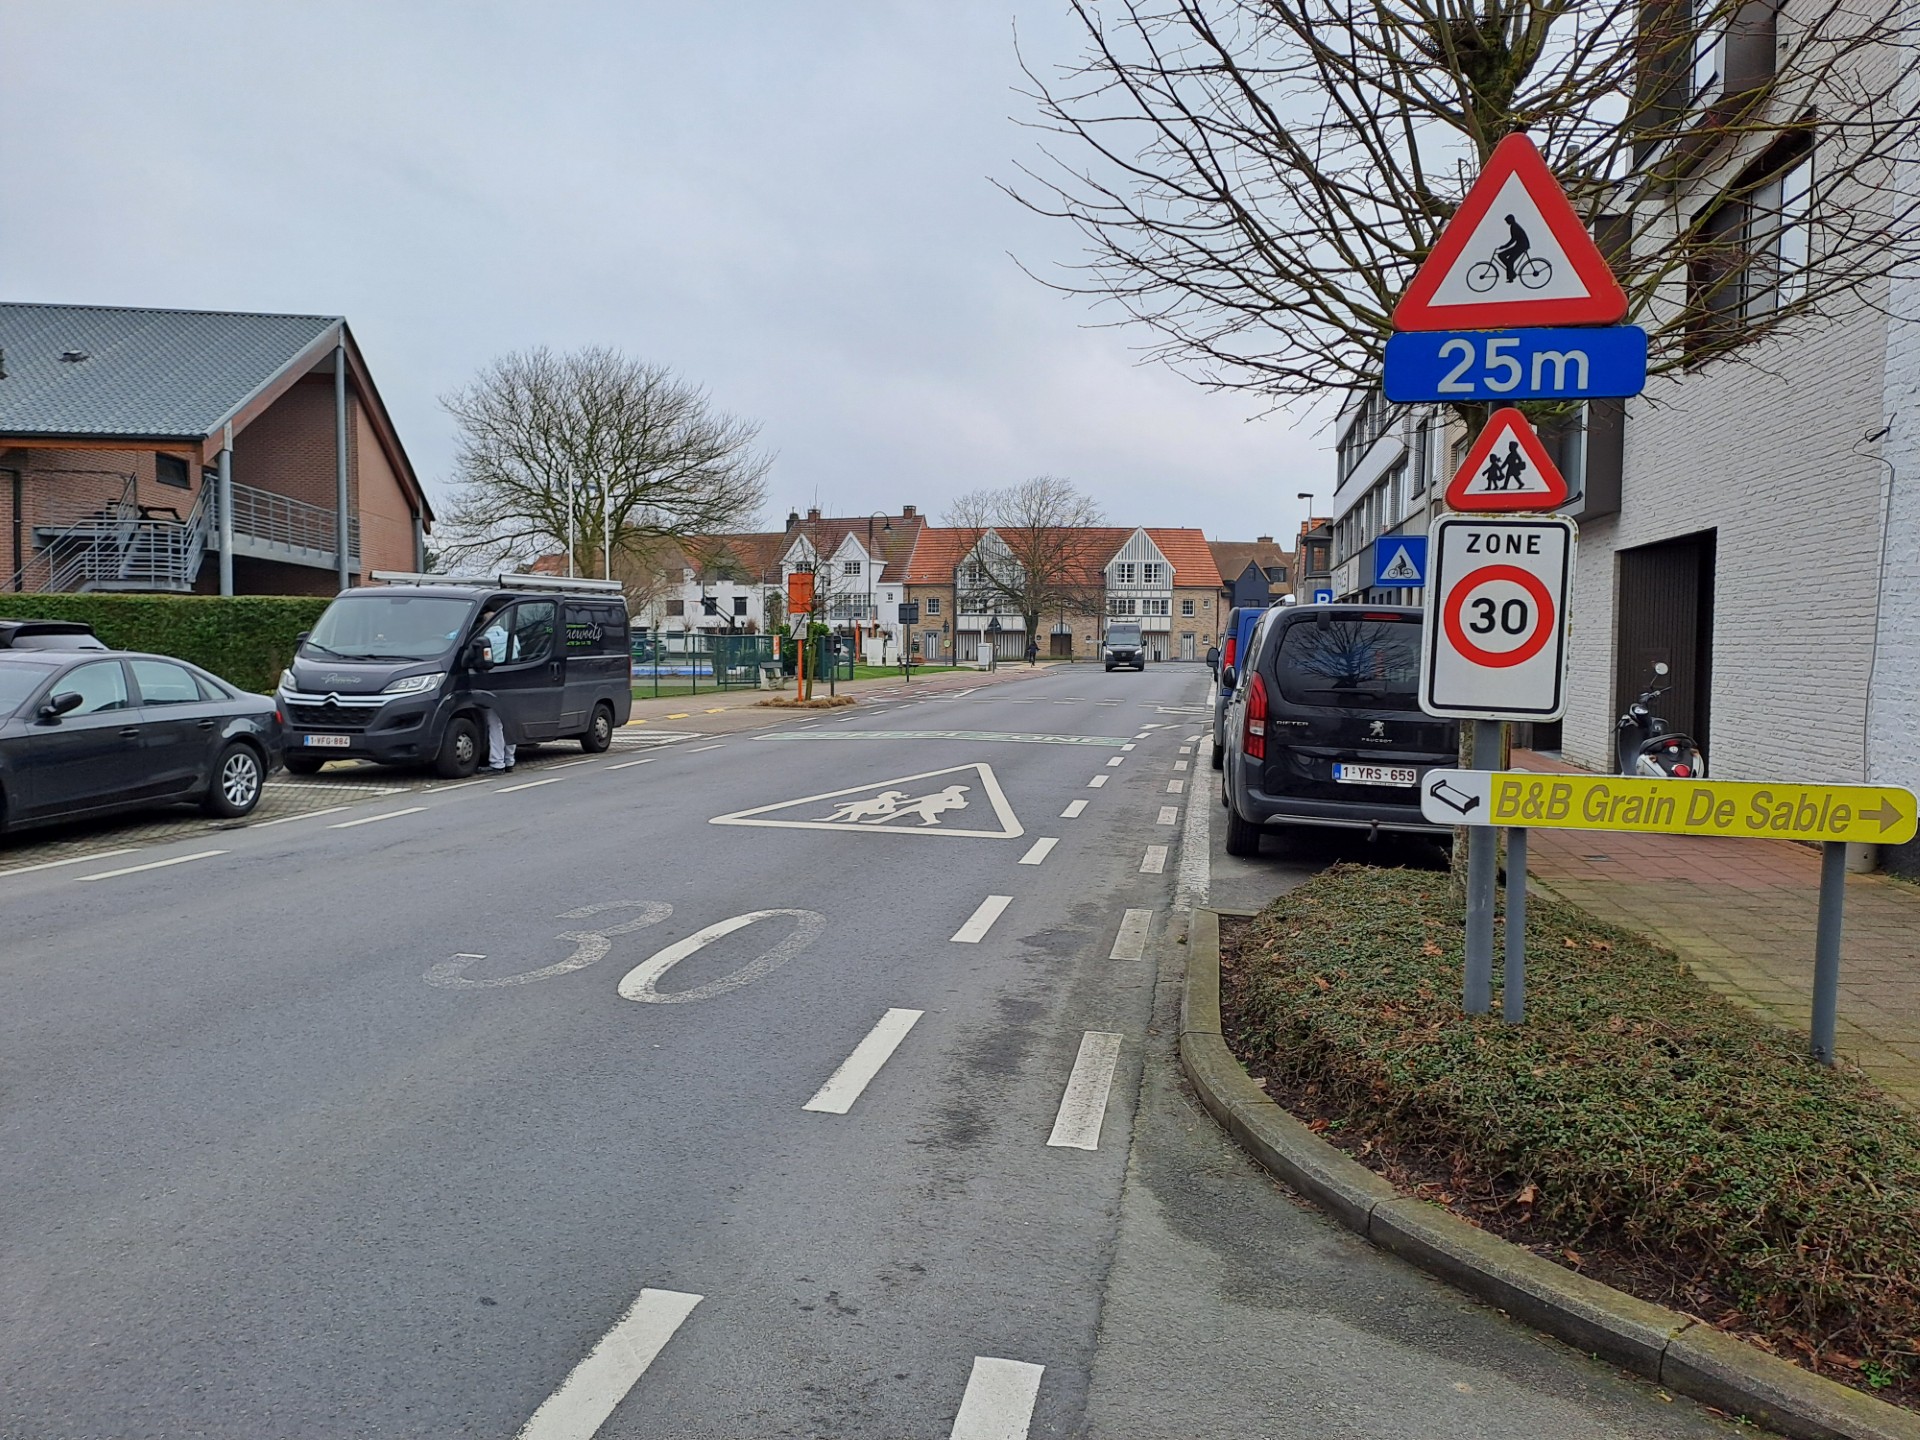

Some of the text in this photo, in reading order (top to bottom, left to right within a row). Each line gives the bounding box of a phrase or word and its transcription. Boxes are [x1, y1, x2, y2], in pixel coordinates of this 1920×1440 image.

[1437, 337, 1590, 393] 25m
[1466, 533, 1541, 555] ZONE
[1316, 593, 1331, 604] P
[1469, 597, 1528, 635] 30
[310, 736, 349, 745] 1-VFG-884
[1343, 766, 1415, 782] 1-YRS-659
[1496, 780, 1852, 834] B&B Grain De Sable
[421, 899, 828, 1004] 30
